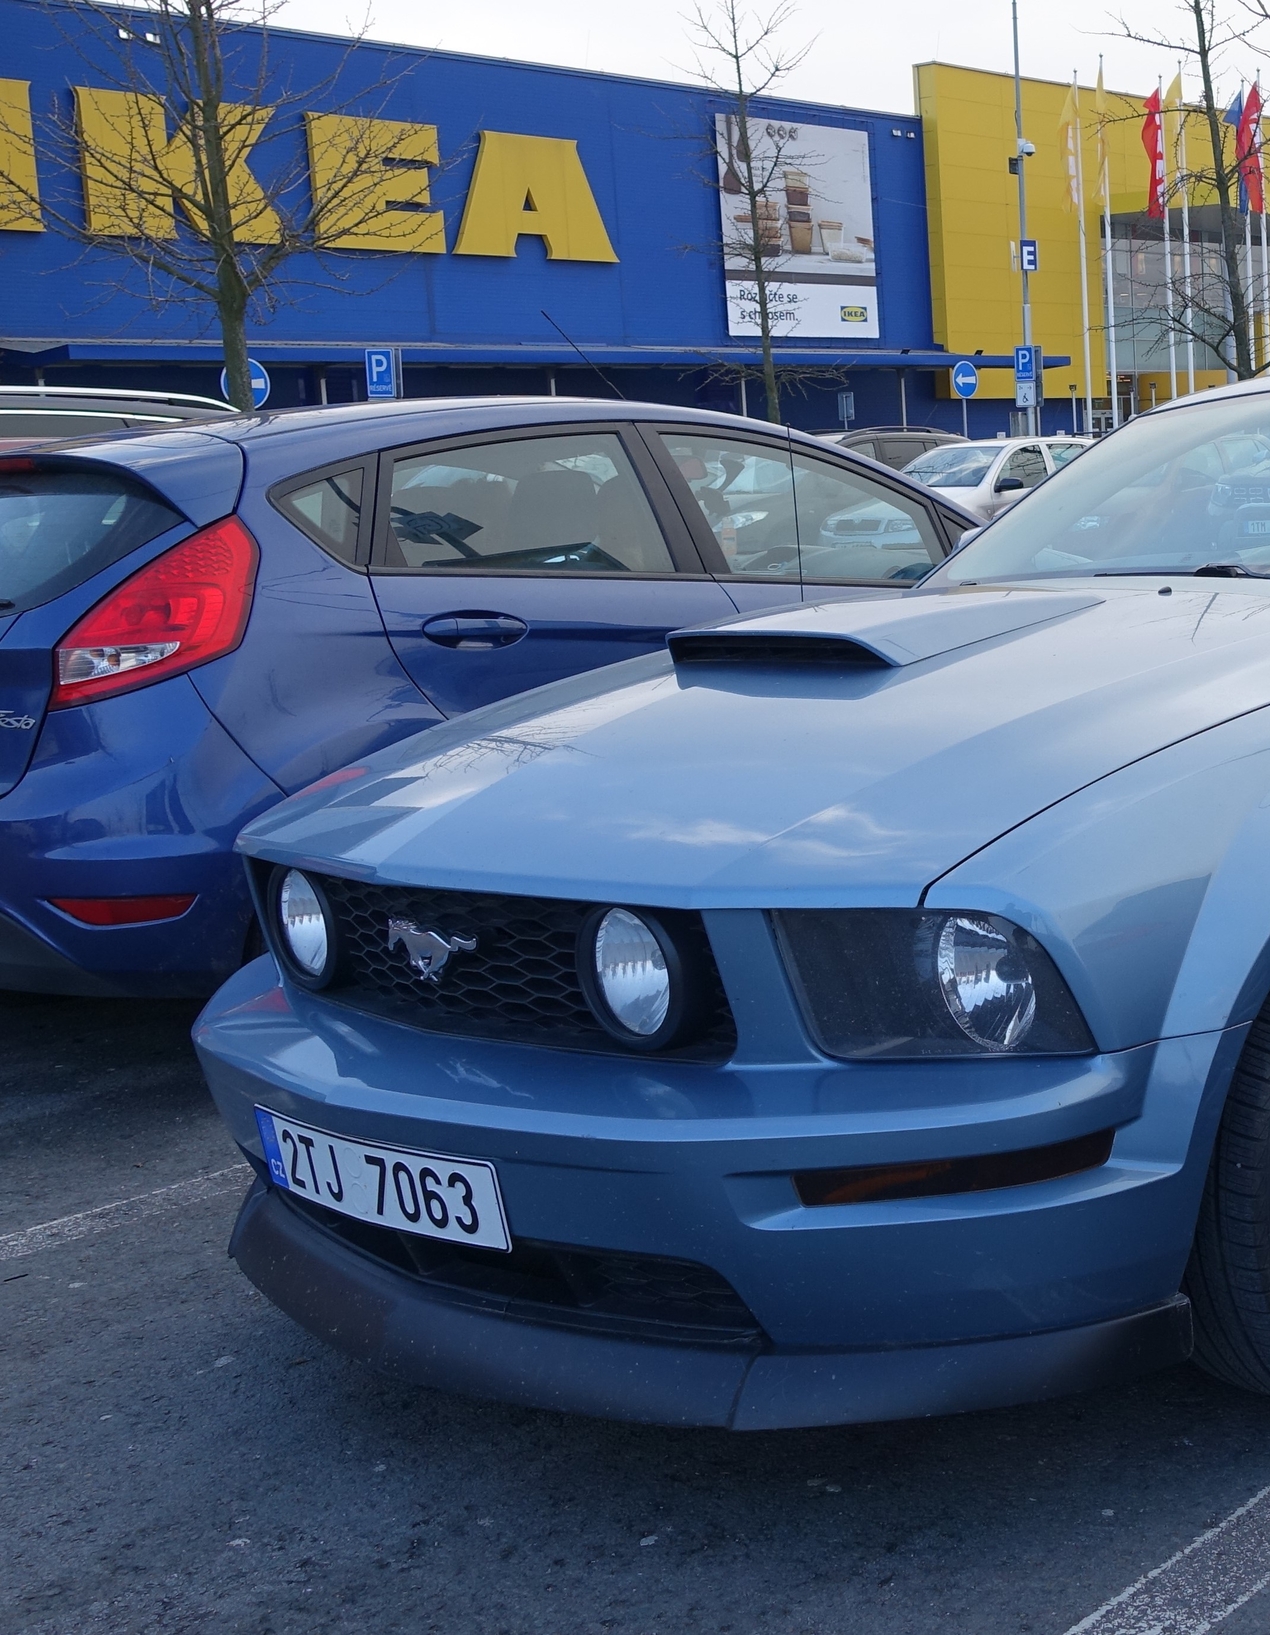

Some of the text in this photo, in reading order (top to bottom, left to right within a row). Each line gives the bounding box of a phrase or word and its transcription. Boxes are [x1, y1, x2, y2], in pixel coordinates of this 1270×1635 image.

[1022, 246, 1035, 270] E
[739, 289, 798, 303] Rozčte se
[740, 308, 798, 321] s chosem.
[843, 310, 866, 318] IKEA
[371, 354, 388, 382] P
[1018, 350, 1030, 370] P
[1251, 521, 1266, 532] 1TM
[270, 1157, 286, 1179] CZ
[281, 1128, 480, 1235] 2TJ 7063
